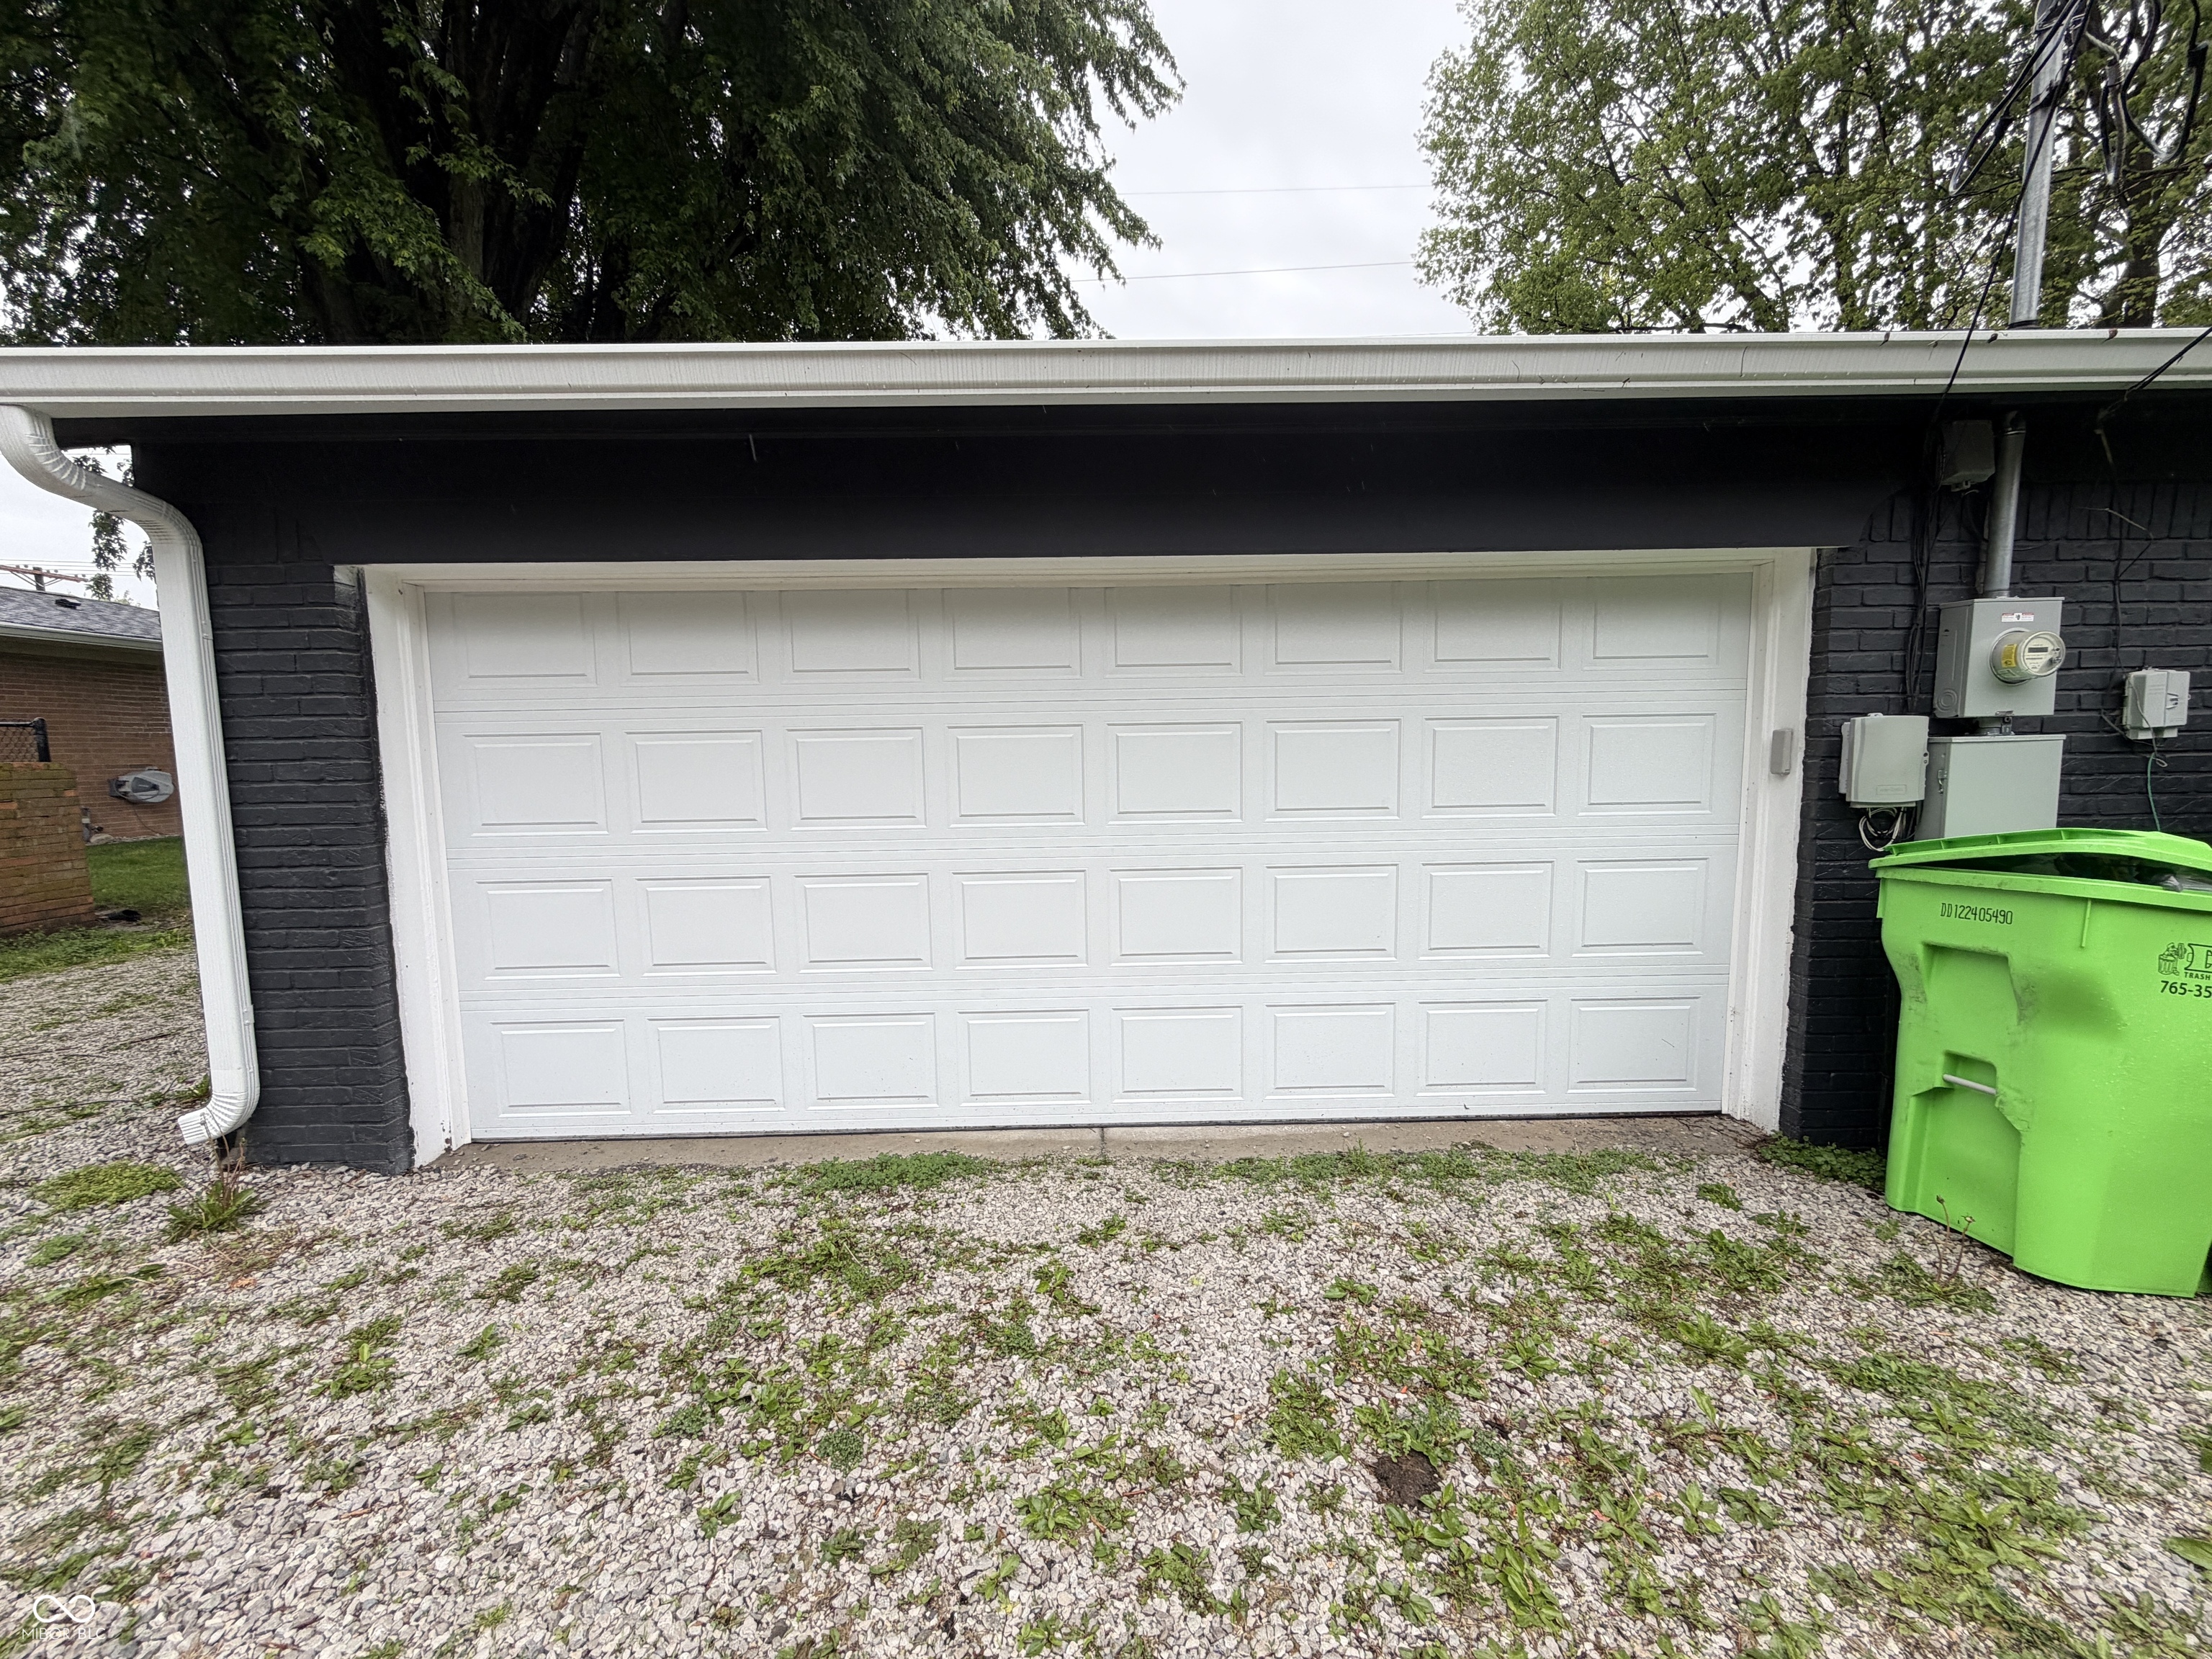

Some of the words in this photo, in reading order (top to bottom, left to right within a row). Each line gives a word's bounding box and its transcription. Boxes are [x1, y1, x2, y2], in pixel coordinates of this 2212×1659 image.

[1940, 902, 2013, 925] DD122405490
[2184, 971, 2211, 981] TRASH
[2160, 980, 2212, 999] 765-35
